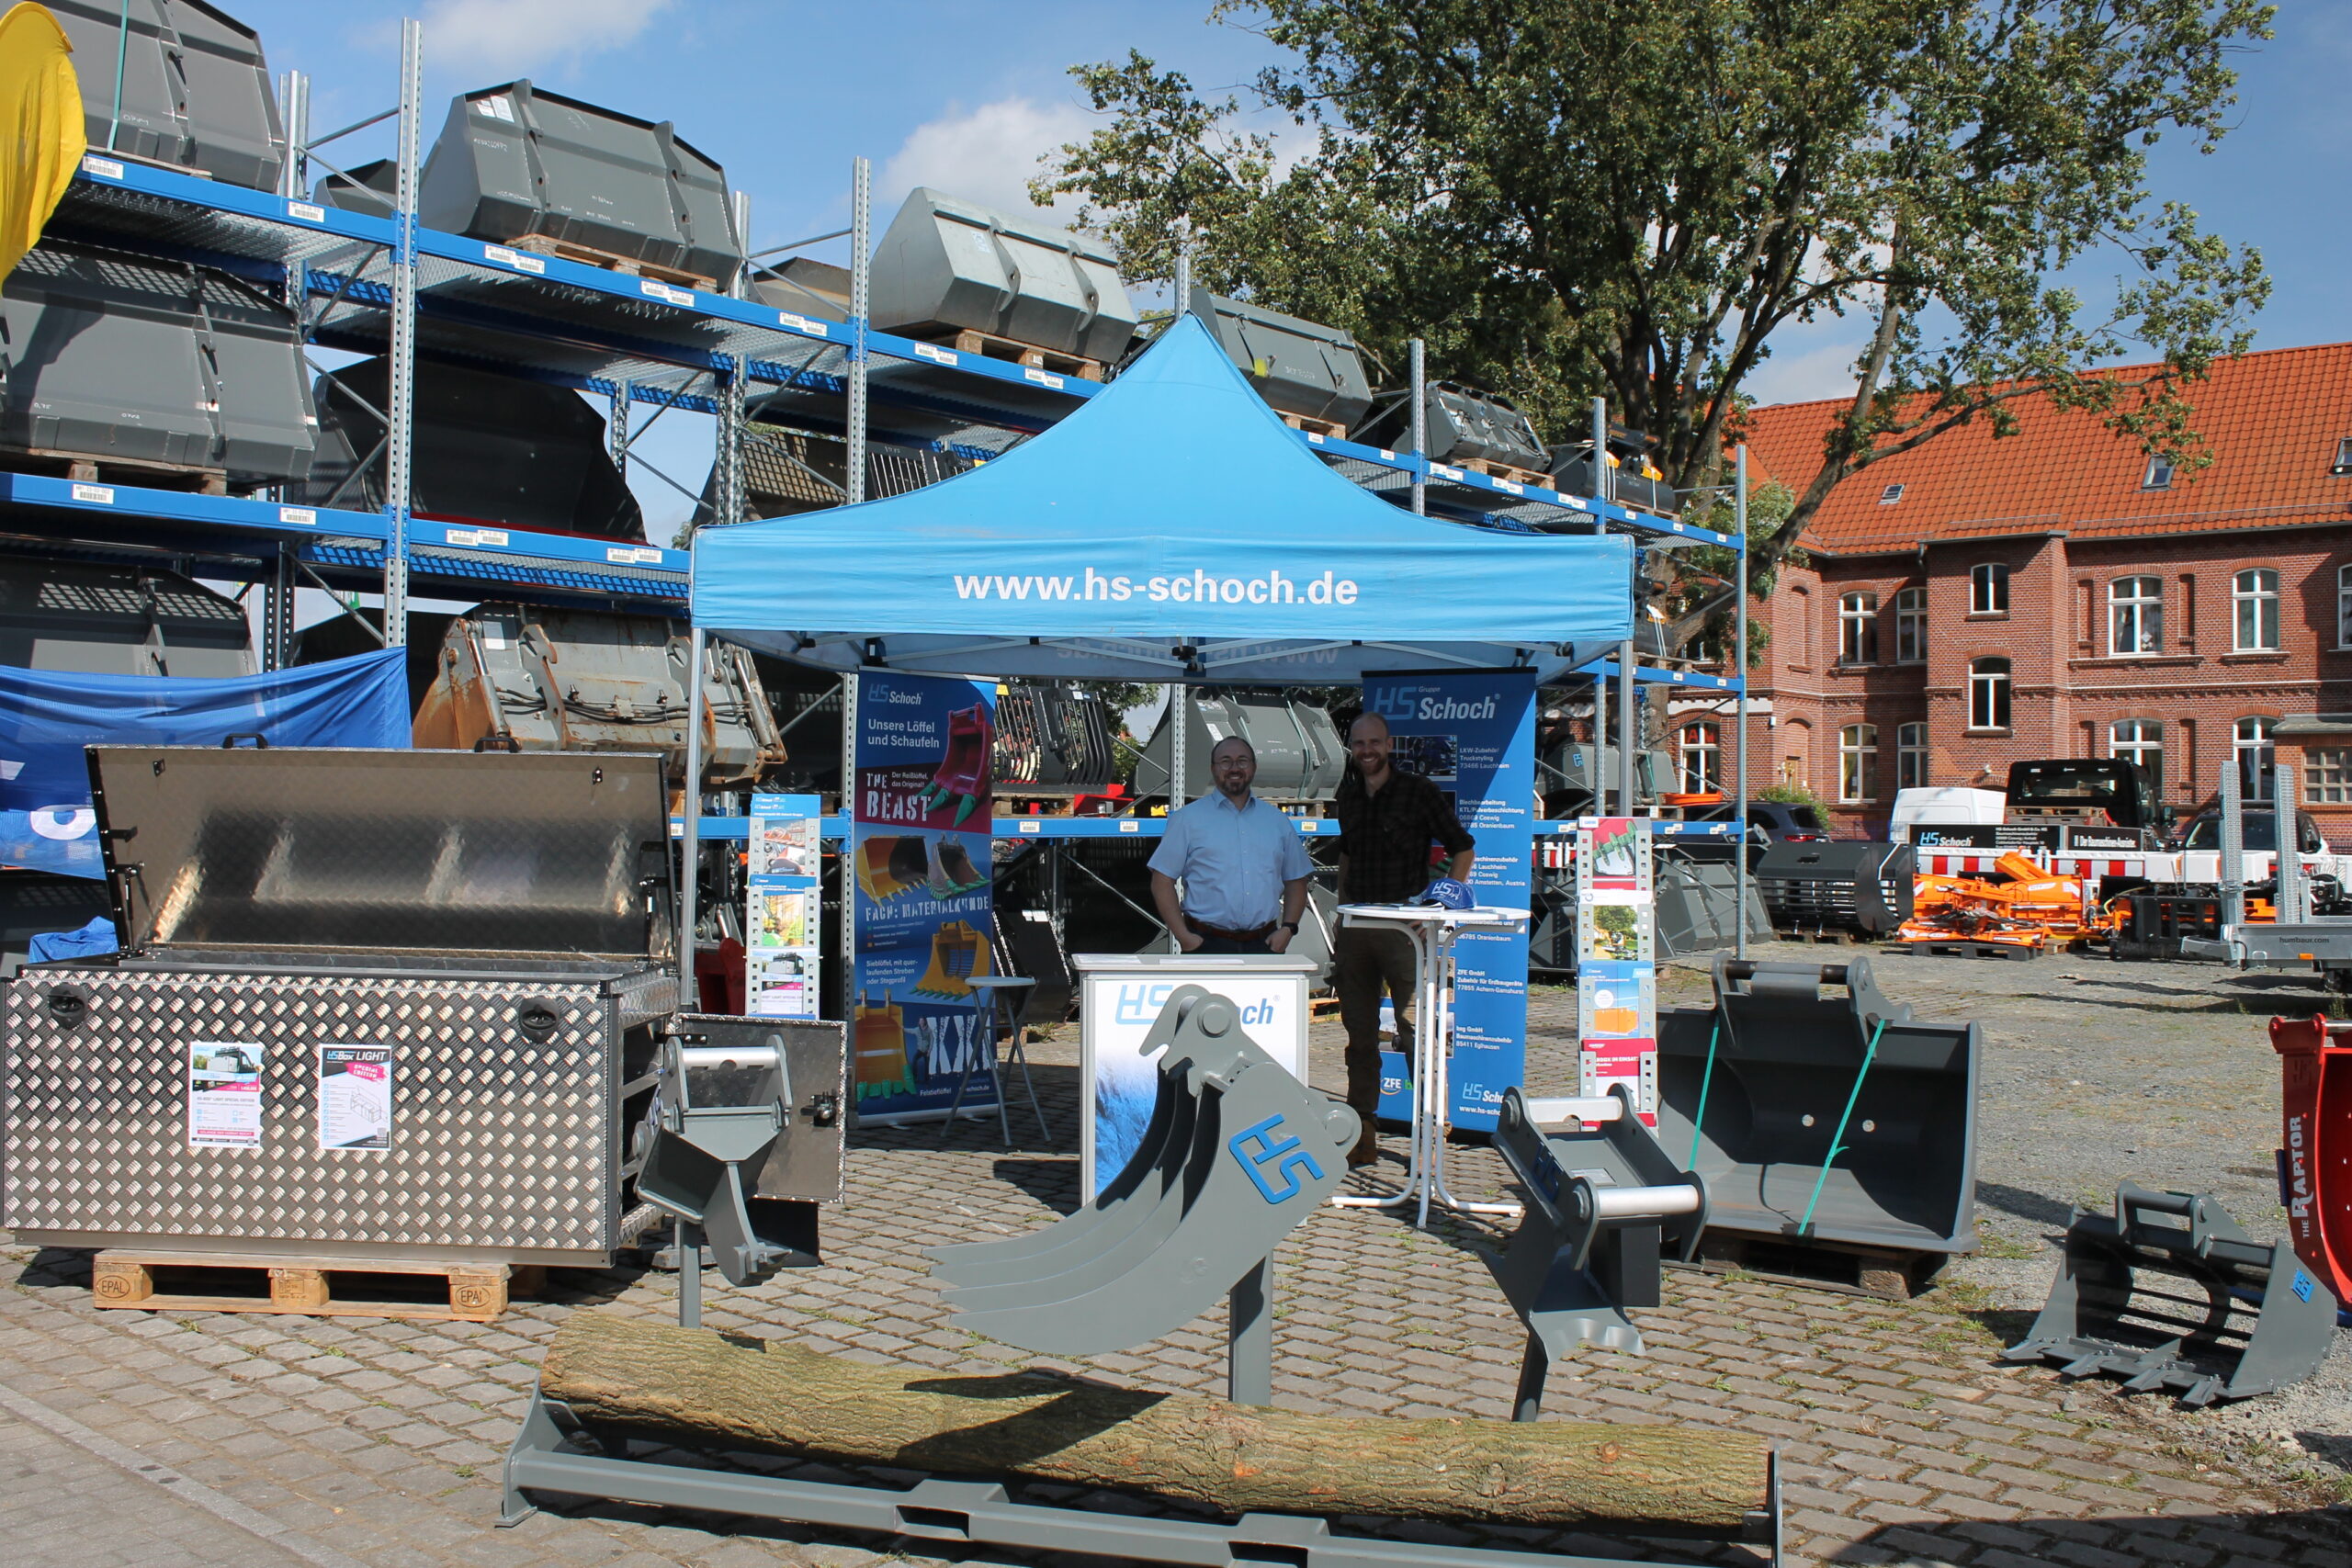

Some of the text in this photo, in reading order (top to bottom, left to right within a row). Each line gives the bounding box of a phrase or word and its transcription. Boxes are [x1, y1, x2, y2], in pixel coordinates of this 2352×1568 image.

[954, 567, 1358, 604] www.hs-schoch.de
[889, 691, 922, 705] Schoch
[1374, 687, 1417, 720] HS
[1419, 695, 1496, 720] Schoch
[868, 718, 935, 734] Unsere Löffel
[868, 734, 940, 749] und Schaufeln
[866, 773, 888, 789] THE
[866, 790, 932, 822] BEAST
[1920, 832, 1972, 847] HS Schoch
[356, 1051, 387, 1061] LIGHT
[354, 1064, 379, 1073] SPECIAL
[1383, 1077, 1401, 1089] ZFE
[1463, 1082, 1504, 1103] HS Scho
[1228, 1113, 1325, 1204] HS
[2290, 1116, 2314, 1218] RAPTOR
[2301, 1220, 2310, 1238] THE
[101, 1280, 126, 1294] EPAL
